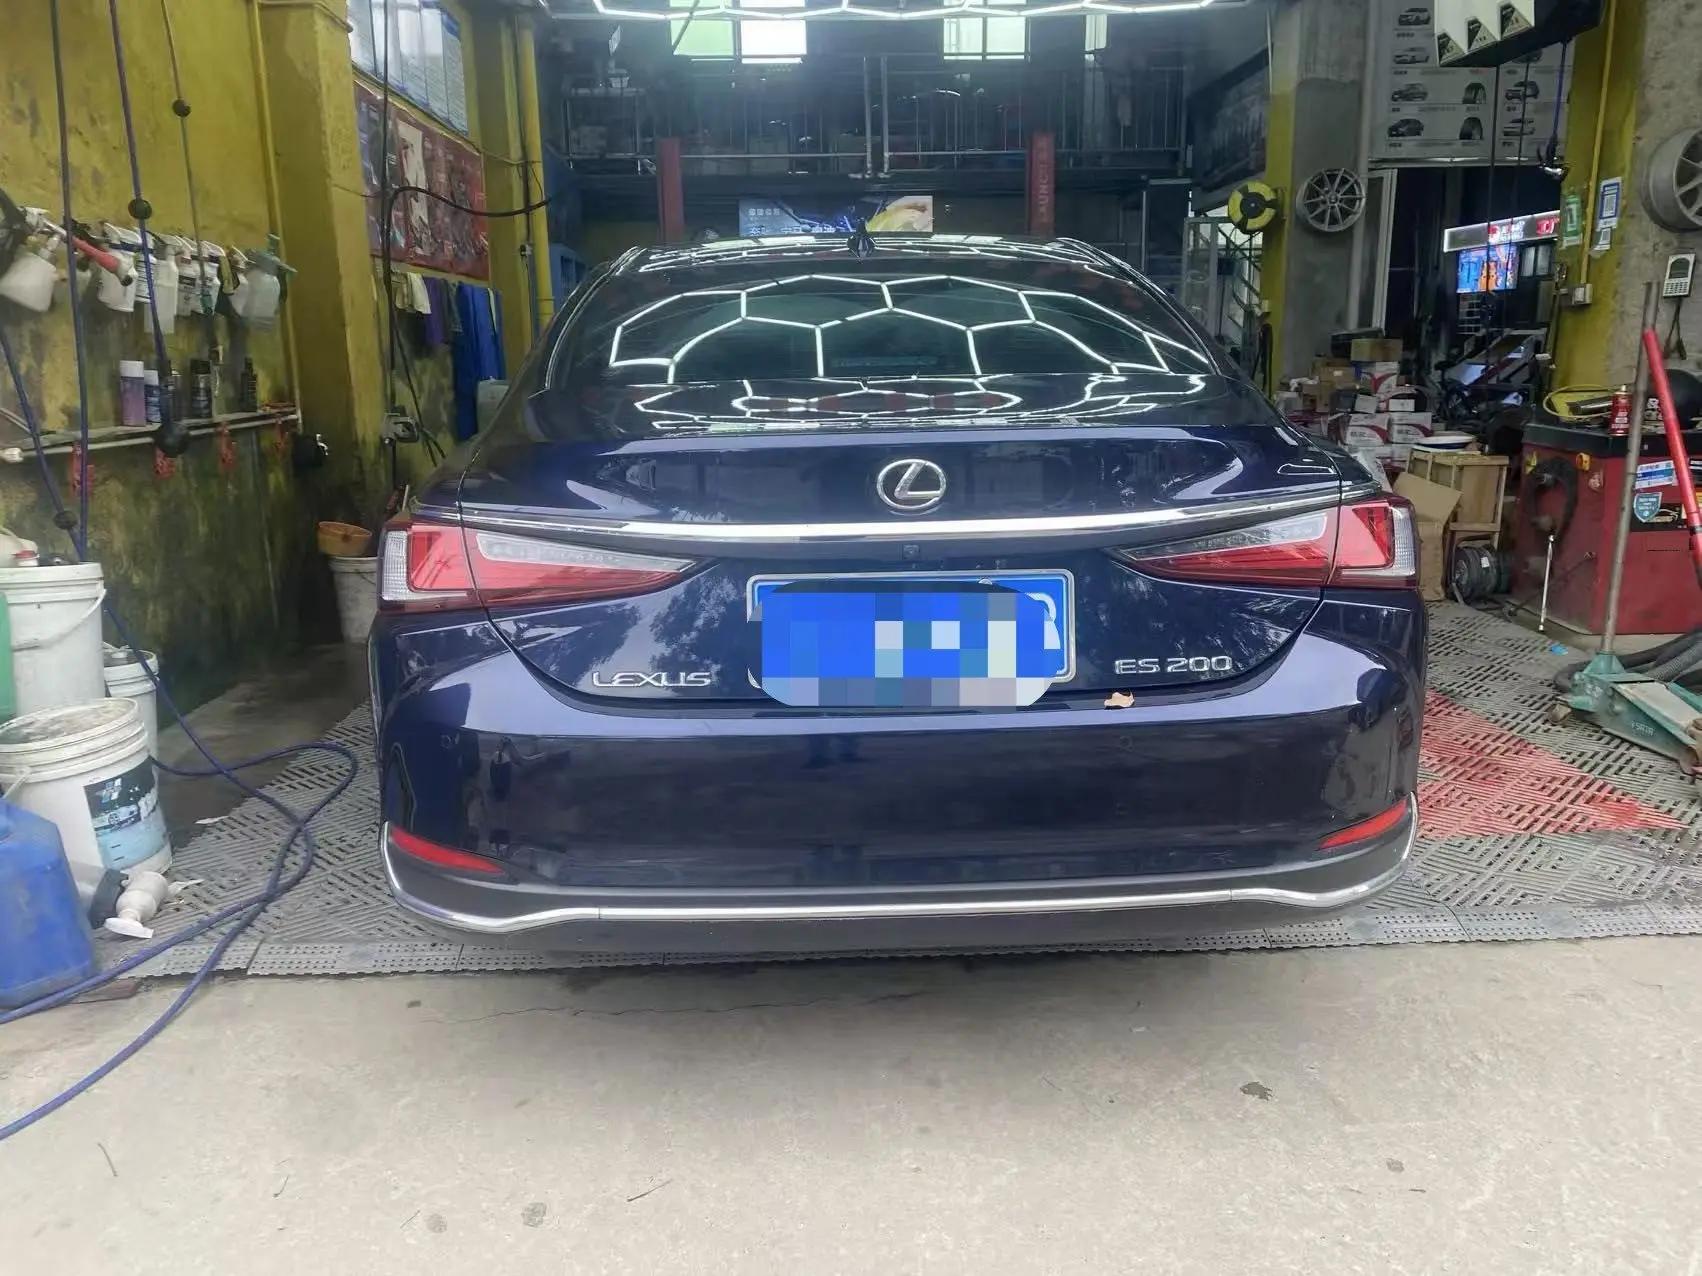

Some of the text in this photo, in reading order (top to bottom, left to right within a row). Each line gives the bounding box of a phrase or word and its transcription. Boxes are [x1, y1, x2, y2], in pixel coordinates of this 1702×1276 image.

[1115, 655, 1232, 674] ES 200
[592, 671, 711, 687] LEXUS
